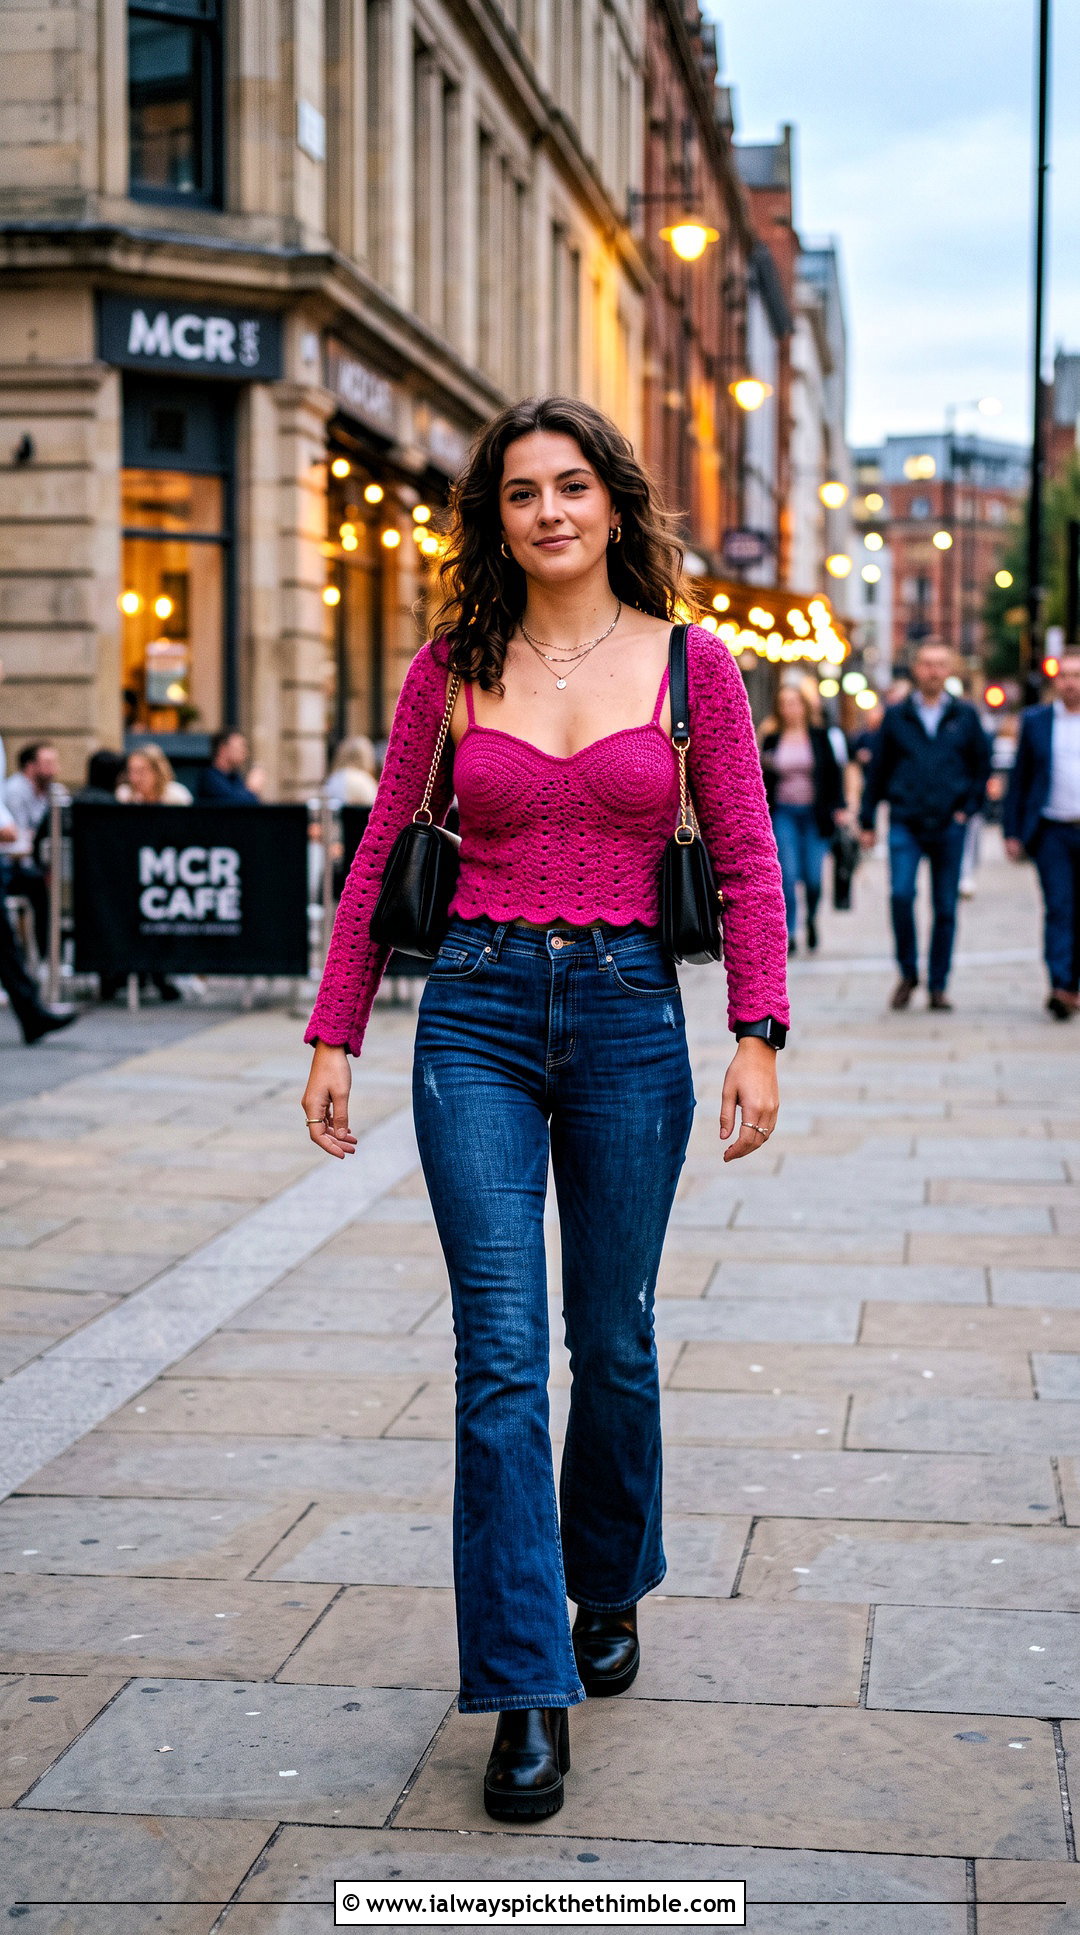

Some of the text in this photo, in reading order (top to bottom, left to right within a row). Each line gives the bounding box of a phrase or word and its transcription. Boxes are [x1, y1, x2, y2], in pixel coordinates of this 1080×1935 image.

[127, 309, 237, 364] MCR
[139, 846, 241, 886] MCR
[139, 886, 241, 921] CAFE
